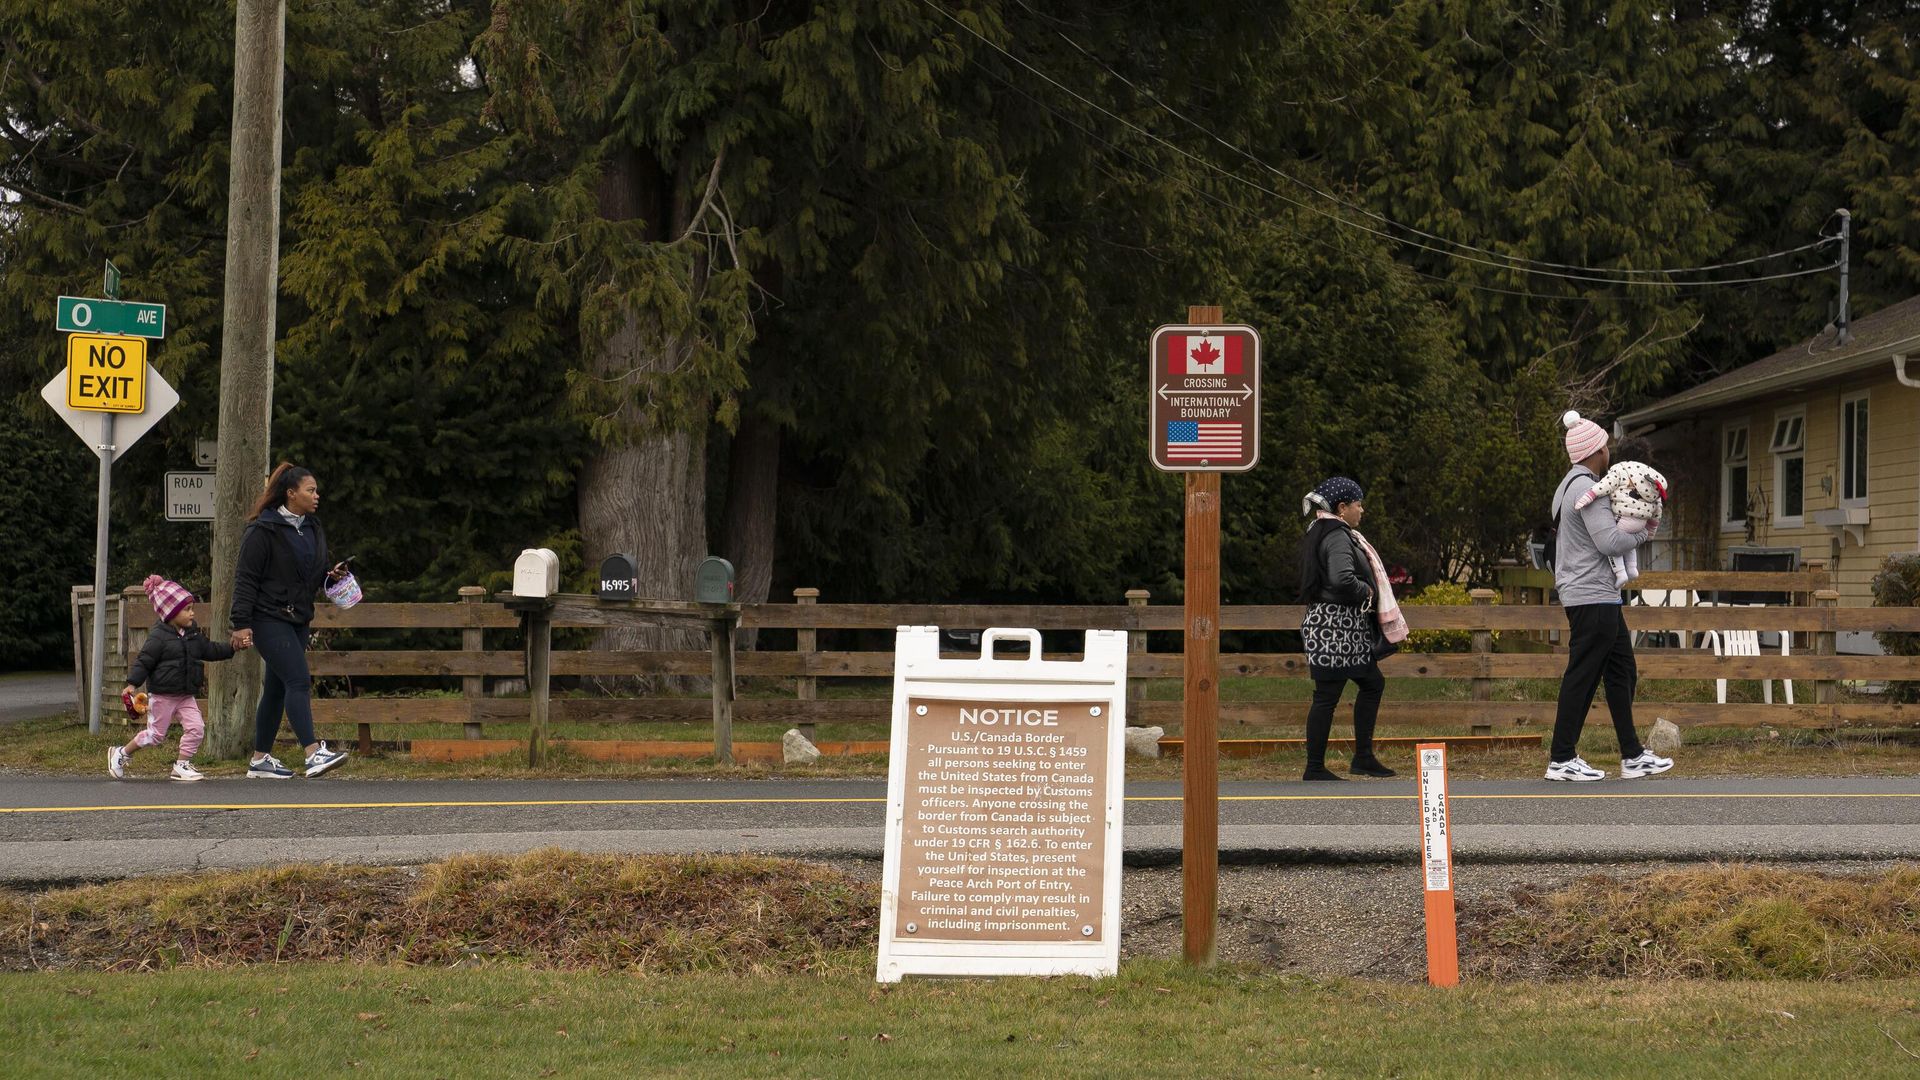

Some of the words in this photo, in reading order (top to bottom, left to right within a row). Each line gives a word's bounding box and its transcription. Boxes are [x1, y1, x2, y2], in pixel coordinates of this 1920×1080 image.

[136, 309, 157, 325] AVE
[89, 345, 126, 369] NO
[79, 375, 134, 399] EXIT
[1183, 378, 1227, 388] CROSSING
[1170, 397, 1241, 407] INTERNATIONAL
[1181, 408, 1231, 418] BOUNDARY
[174, 477, 203, 488] ROAD
[173, 504, 201, 515] THRU
[601, 580, 630, 591] 16995
[960, 708, 1059, 726] NOTICE
[951, 731, 1022, 743] U.S./Canada
[1026, 733, 1064, 744] Border
[928, 744, 978, 755] Pursuant
[982, 746, 994, 755] to
[997, 746, 1010, 756] 19
[1014, 746, 1047, 756] U.S.C.
[1059, 747, 1087, 757] 1459
[928, 758, 941, 767] all
[945, 759, 989, 771] persons
[992, 759, 1036, 771] seeking
[1039, 761, 1051, 769] to
[1054, 761, 1085, 770] enter
[918, 771, 937, 780] the
[941, 771, 978, 781] United
[982, 772, 1017, 782] States
[1021, 772, 1048, 782] from
[1051, 773, 1094, 784] Canada
[918, 785, 947, 794] must
[950, 784, 964, 794] be
[968, 785, 1023, 797] inspected
[1026, 786, 1040, 797] by
[1044, 786, 1092, 797] Customs
[1422, 771, 1430, 813] UNITED
[921, 797, 969, 808] officers.
[972, 799, 1016, 811] Anyone
[1019, 800, 1066, 811] crossing
[1069, 800, 1088, 810] the
[918, 811, 956, 821] border
[960, 812, 987, 821] from
[991, 812, 1033, 823] Canada
[1037, 813, 1045, 823] is
[1049, 813, 1091, 826] subject
[1438, 793, 1446, 836] CANADA
[922, 825, 934, 834] to
[938, 825, 987, 835] Customs
[990, 825, 1027, 835] search
[1031, 826, 1085, 838] authority
[1424, 816, 1432, 859] STATES
[914, 838, 948, 847] under
[952, 838, 965, 848] 19
[969, 838, 990, 848] CFR
[1006, 839, 1041, 849] 162.6.
[1045, 839, 1058, 849] To
[1061, 840, 1092, 850] enter
[925, 851, 944, 861] the
[948, 852, 987, 862] United
[990, 852, 1028, 864] States,
[1032, 854, 1076, 864] present
[918, 865, 965, 876] yourself
[968, 865, 984, 875] for
[988, 866, 1048, 878] inspection
[1052, 867, 1063, 876] at
[1067, 867, 1086, 877] the
[930, 878, 963, 888] Peace
[967, 879, 992, 889] Arch
[997, 879, 1021, 890] Port
[1025, 880, 1036, 890] of
[1040, 880, 1073, 892] Entry.
[911, 891, 950, 901] Failure
[954, 893, 966, 902] to
[969, 892, 1011, 904] comply
[1015, 894, 1039, 904] may
[1042, 894, 1076, 904] result
[1079, 894, 1090, 904] in
[920, 904, 967, 915] criminal
[971, 906, 992, 916] and
[996, 906, 1019, 916] civil
[1022, 907, 1079, 920] penalties,
[928, 919, 981, 931] including
[985, 920, 1070, 932] imprisonment.
